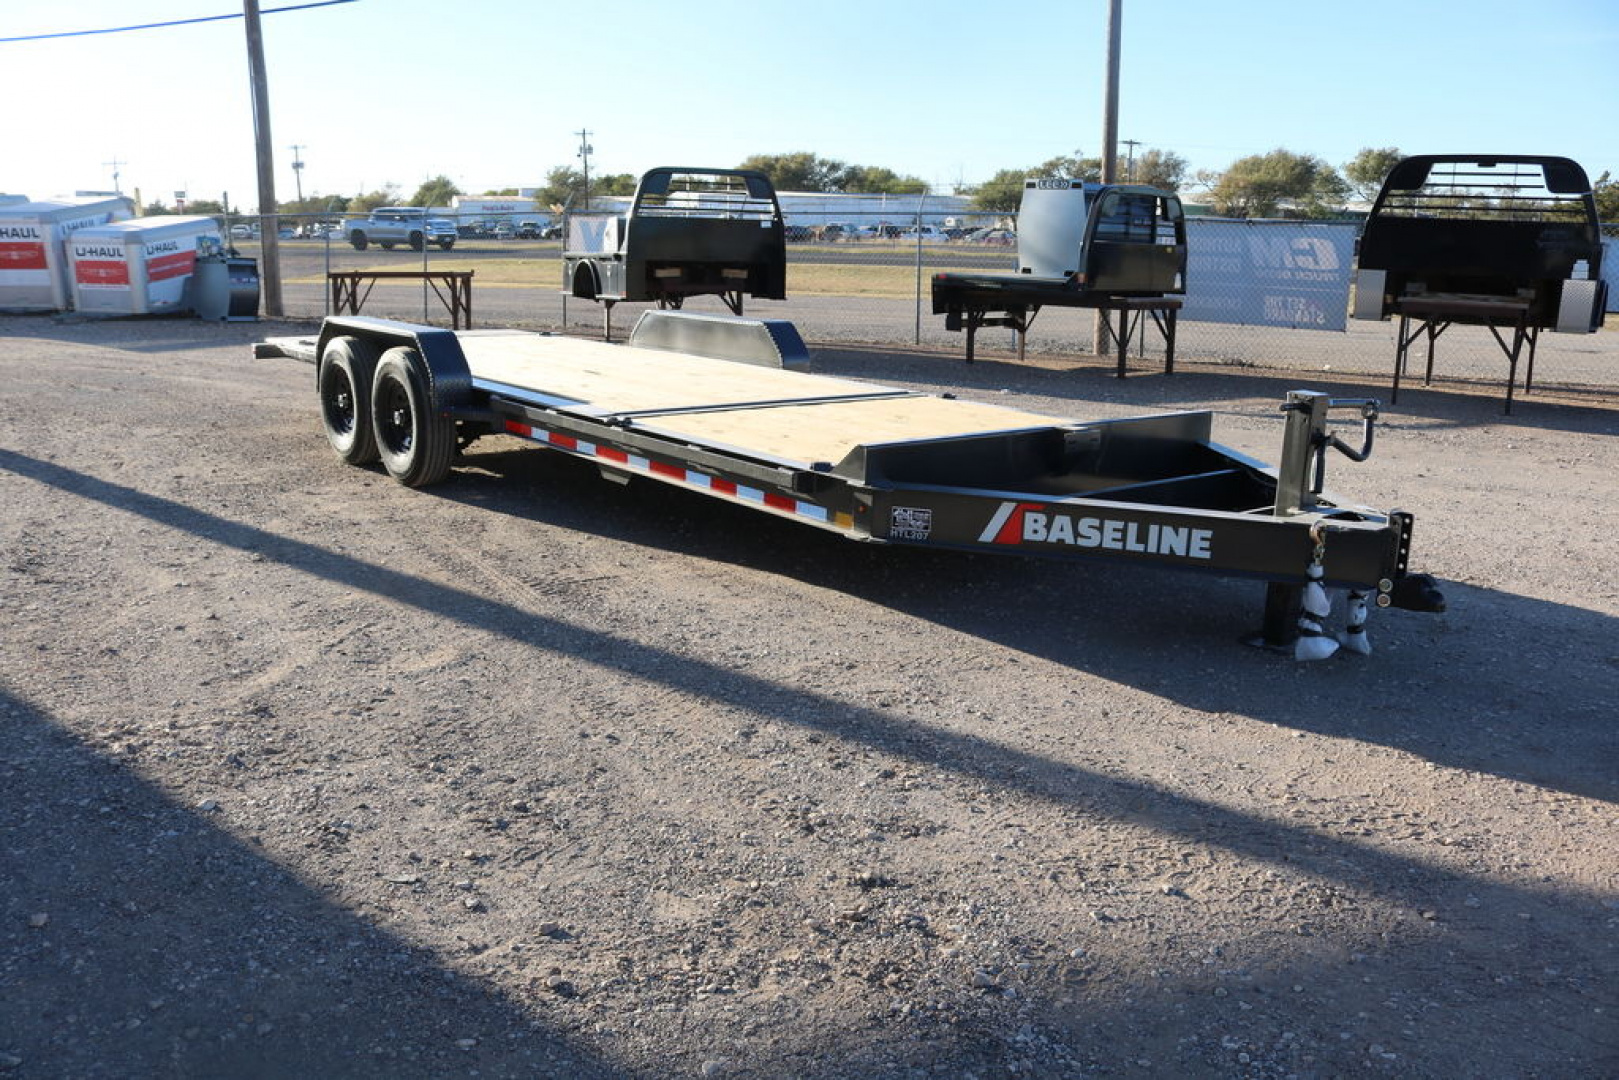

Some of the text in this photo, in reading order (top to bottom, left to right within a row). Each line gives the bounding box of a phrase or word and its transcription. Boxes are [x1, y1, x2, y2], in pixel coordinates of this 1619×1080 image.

[0, 227, 40, 239] HAUL
[76, 247, 124, 257] U-HAUL
[1023, 511, 1213, 558] BASELINE
